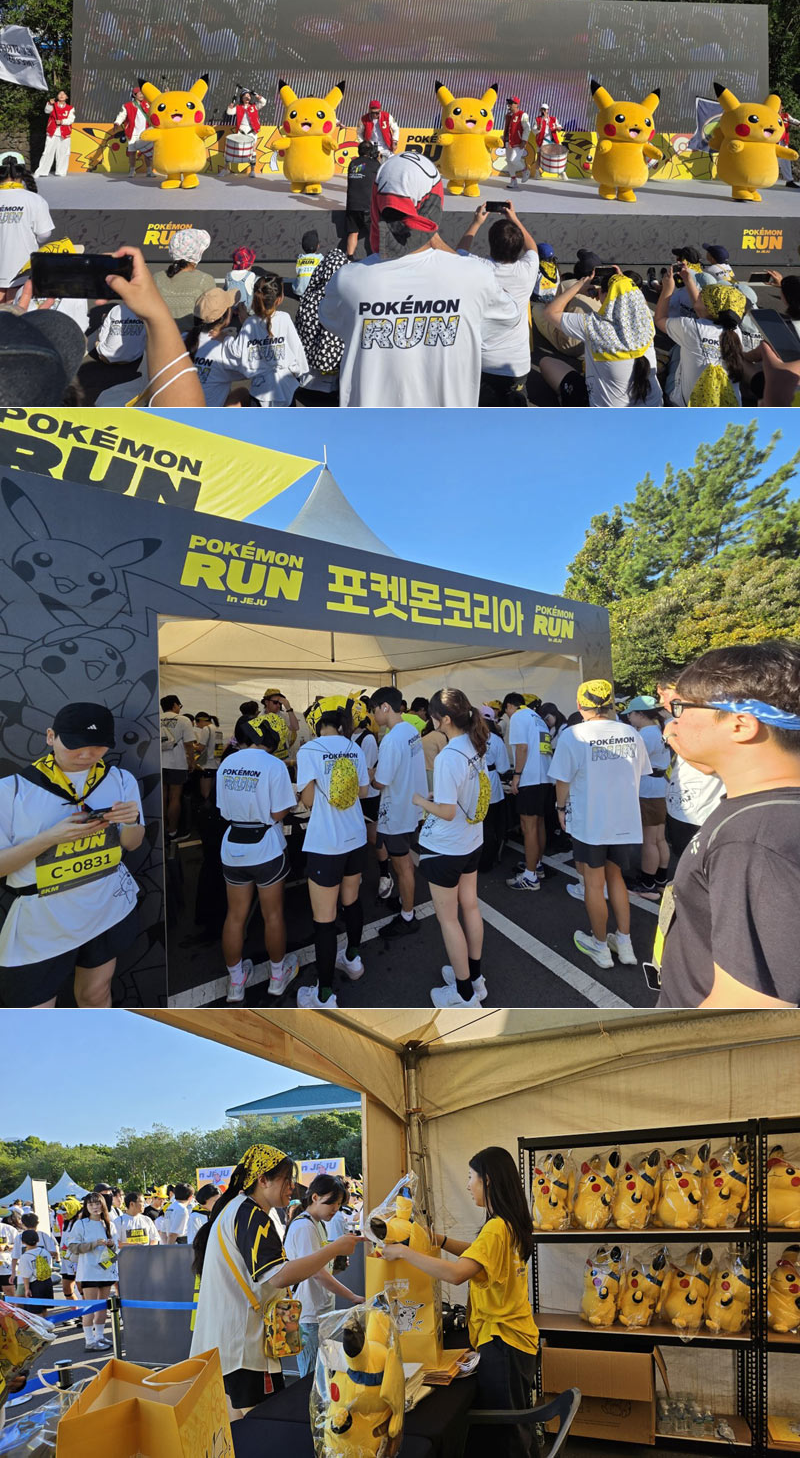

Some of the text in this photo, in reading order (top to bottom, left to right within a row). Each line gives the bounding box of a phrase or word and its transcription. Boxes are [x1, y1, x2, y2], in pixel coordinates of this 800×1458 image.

[147, 221, 193, 231] POKÉMON
[743, 227, 783, 236] POKÉMON
[143, 230, 175, 246] RU
[741, 235, 783, 251] RUN
[359, 294, 461, 316] POKÉMON
[360, 315, 461, 350] RUN
[0, 408, 203, 476] POKÉMON
[188, 534, 304, 570] POKÉMON
[180, 550, 304, 601] RUN
[239, 596, 268, 607] JEJU
[326, 564, 525, 637] 포켓몬코리아
[534, 604, 575, 620] POKÉMON
[532, 614, 575, 640] RUN
[589, 736, 635, 747] POKÉMON
[322, 751, 358, 761] POKÉMON
[222, 767, 261, 778] POKÉMON
[55, 834, 107, 858] RUN
[51, 853, 112, 879] C-0831
